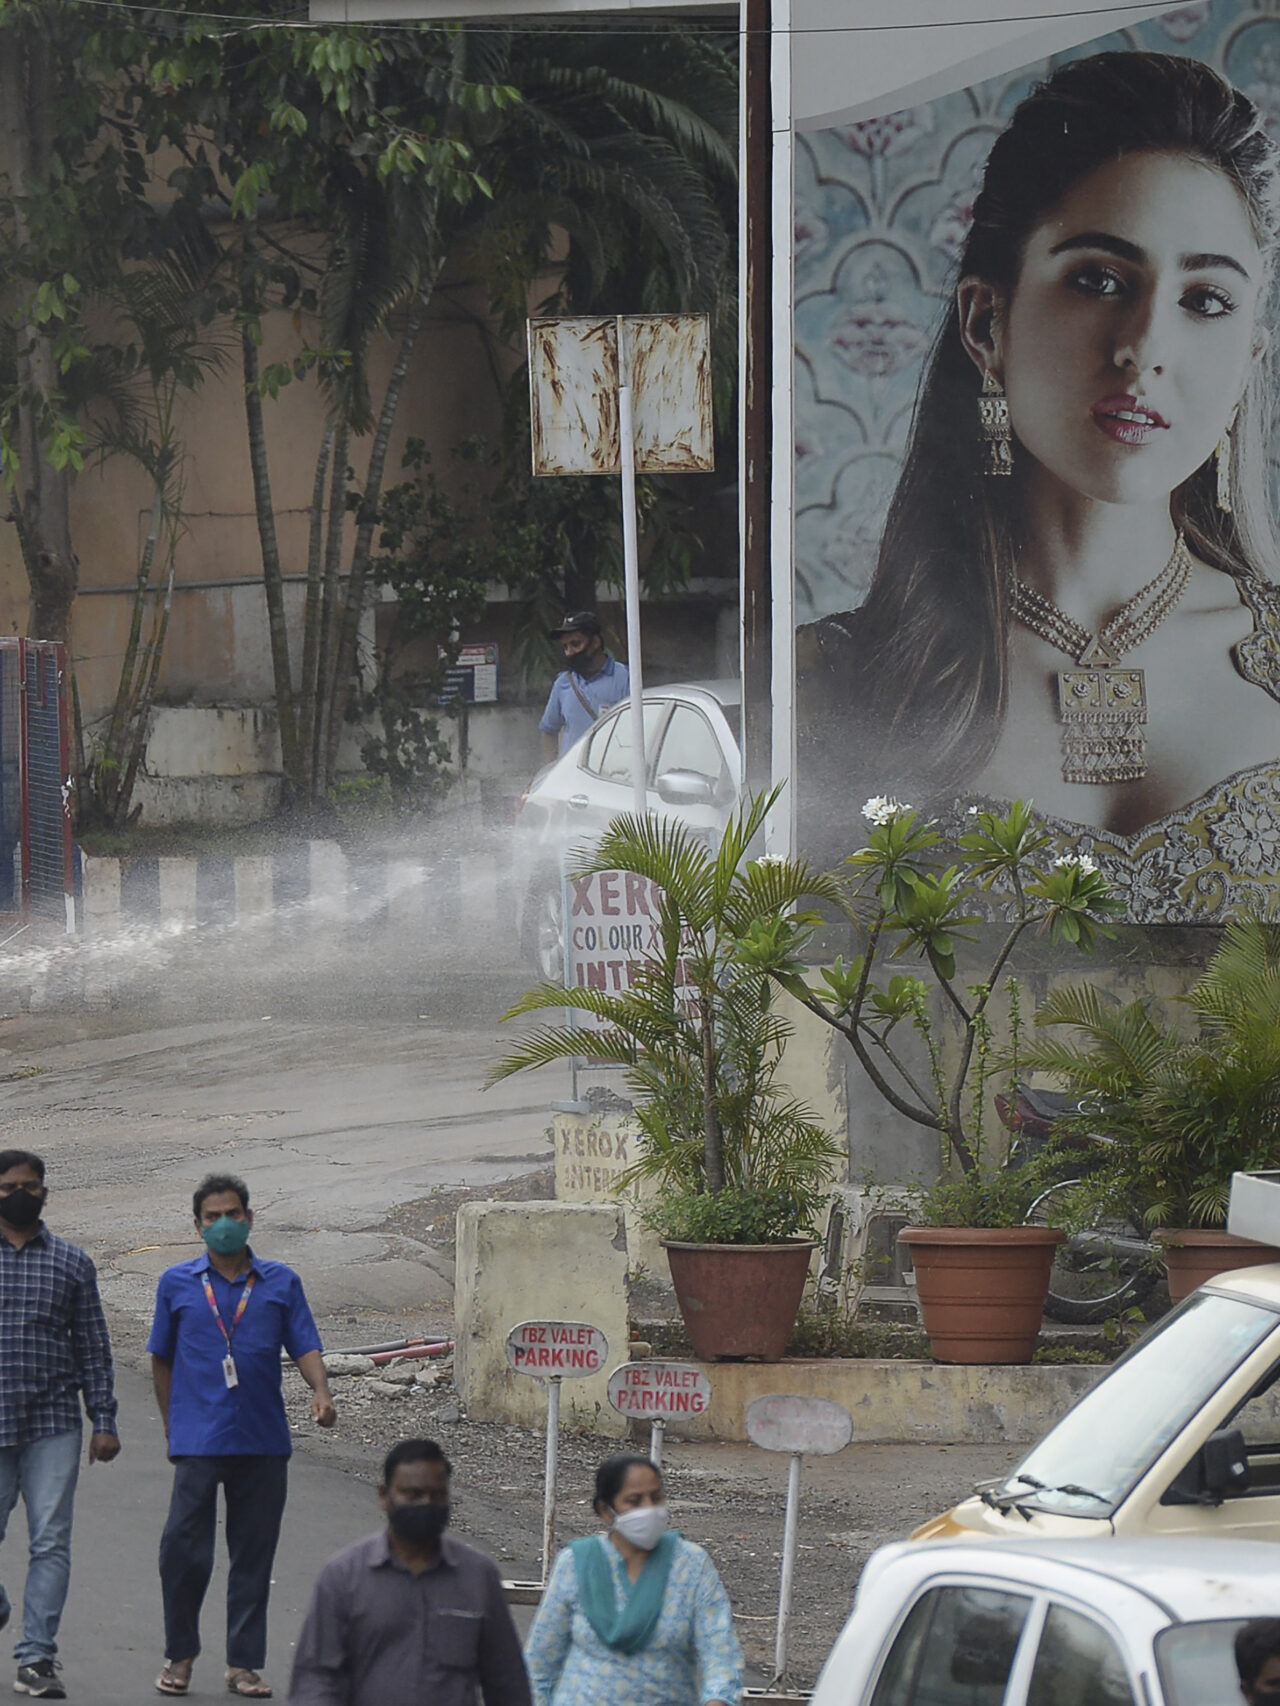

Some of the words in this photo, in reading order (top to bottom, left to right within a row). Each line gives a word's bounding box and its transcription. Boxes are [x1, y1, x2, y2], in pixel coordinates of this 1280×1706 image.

[573, 923, 644, 951] COLOUR
[561, 1128, 629, 1161] XEROX
[552, 1329, 596, 1345] VALET
[514, 1348, 600, 1369] PARKING
[655, 1370, 700, 1388] VALET
[616, 1389, 705, 1413] PARKING
